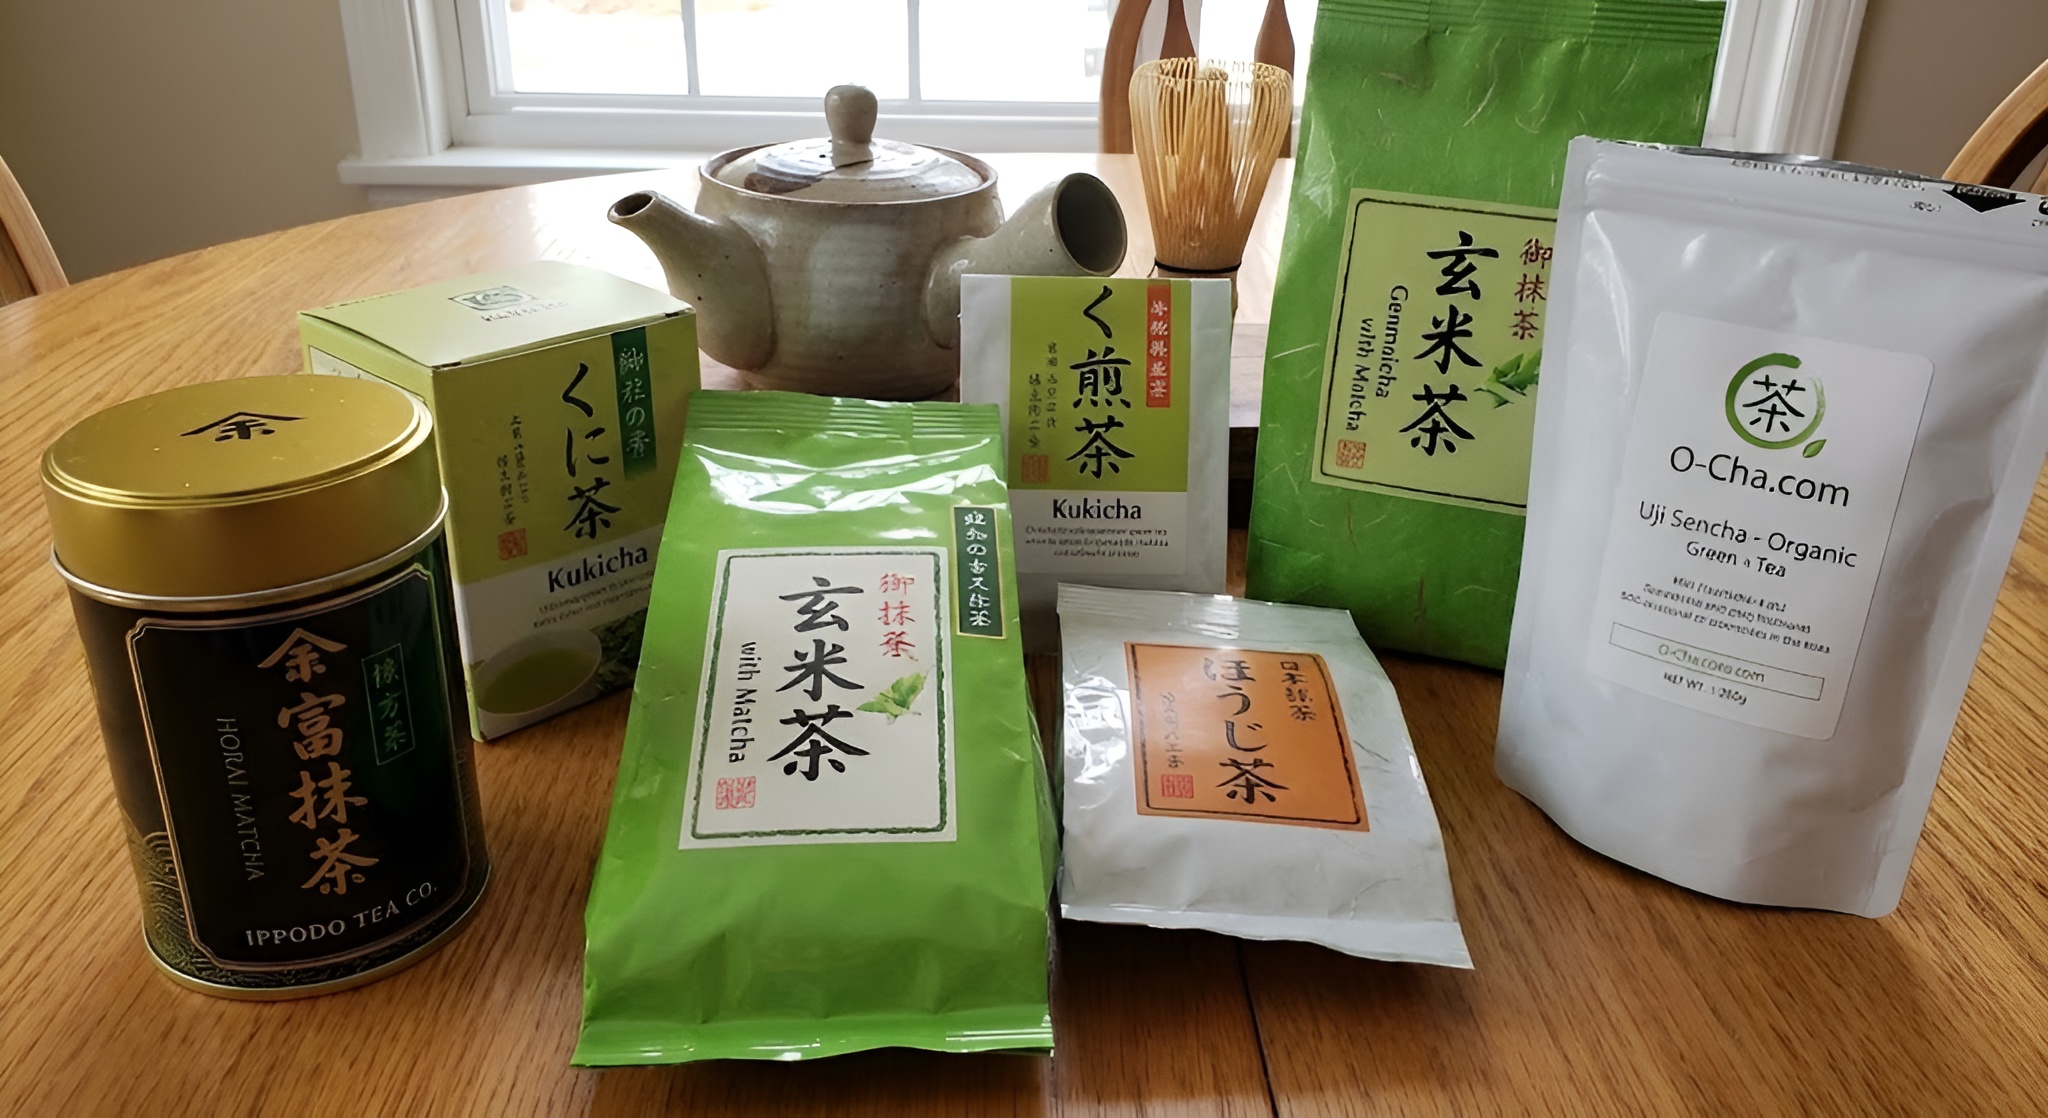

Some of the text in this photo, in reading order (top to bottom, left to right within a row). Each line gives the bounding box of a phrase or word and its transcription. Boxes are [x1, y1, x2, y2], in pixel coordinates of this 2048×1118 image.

[1398, 230, 1499, 456] 玄米茶
[1066, 285, 1135, 479] く煎茶
[1742, 374, 1805, 433] 茶
[562, 362, 621, 539] くに茶
[1670, 446, 1850, 506] O-Cha.com
[1052, 498, 1142, 519] Kukicha
[1639, 501, 1666, 526] Uji
[1671, 509, 1747, 543] Sencha
[1768, 532, 1857, 567] Organic
[548, 547, 648, 593] Kukicha
[1757, 556, 1786, 577] Tea
[738, 642, 761, 680] with
[767, 576, 870, 781] 玄米茶
[729, 689, 757, 763] Matcha
[1203, 657, 1289, 804] ほうじ茶
[216, 718, 264, 881] HORAI MATCHA
[246, 882, 437, 946] IPPODO TEA CO.
